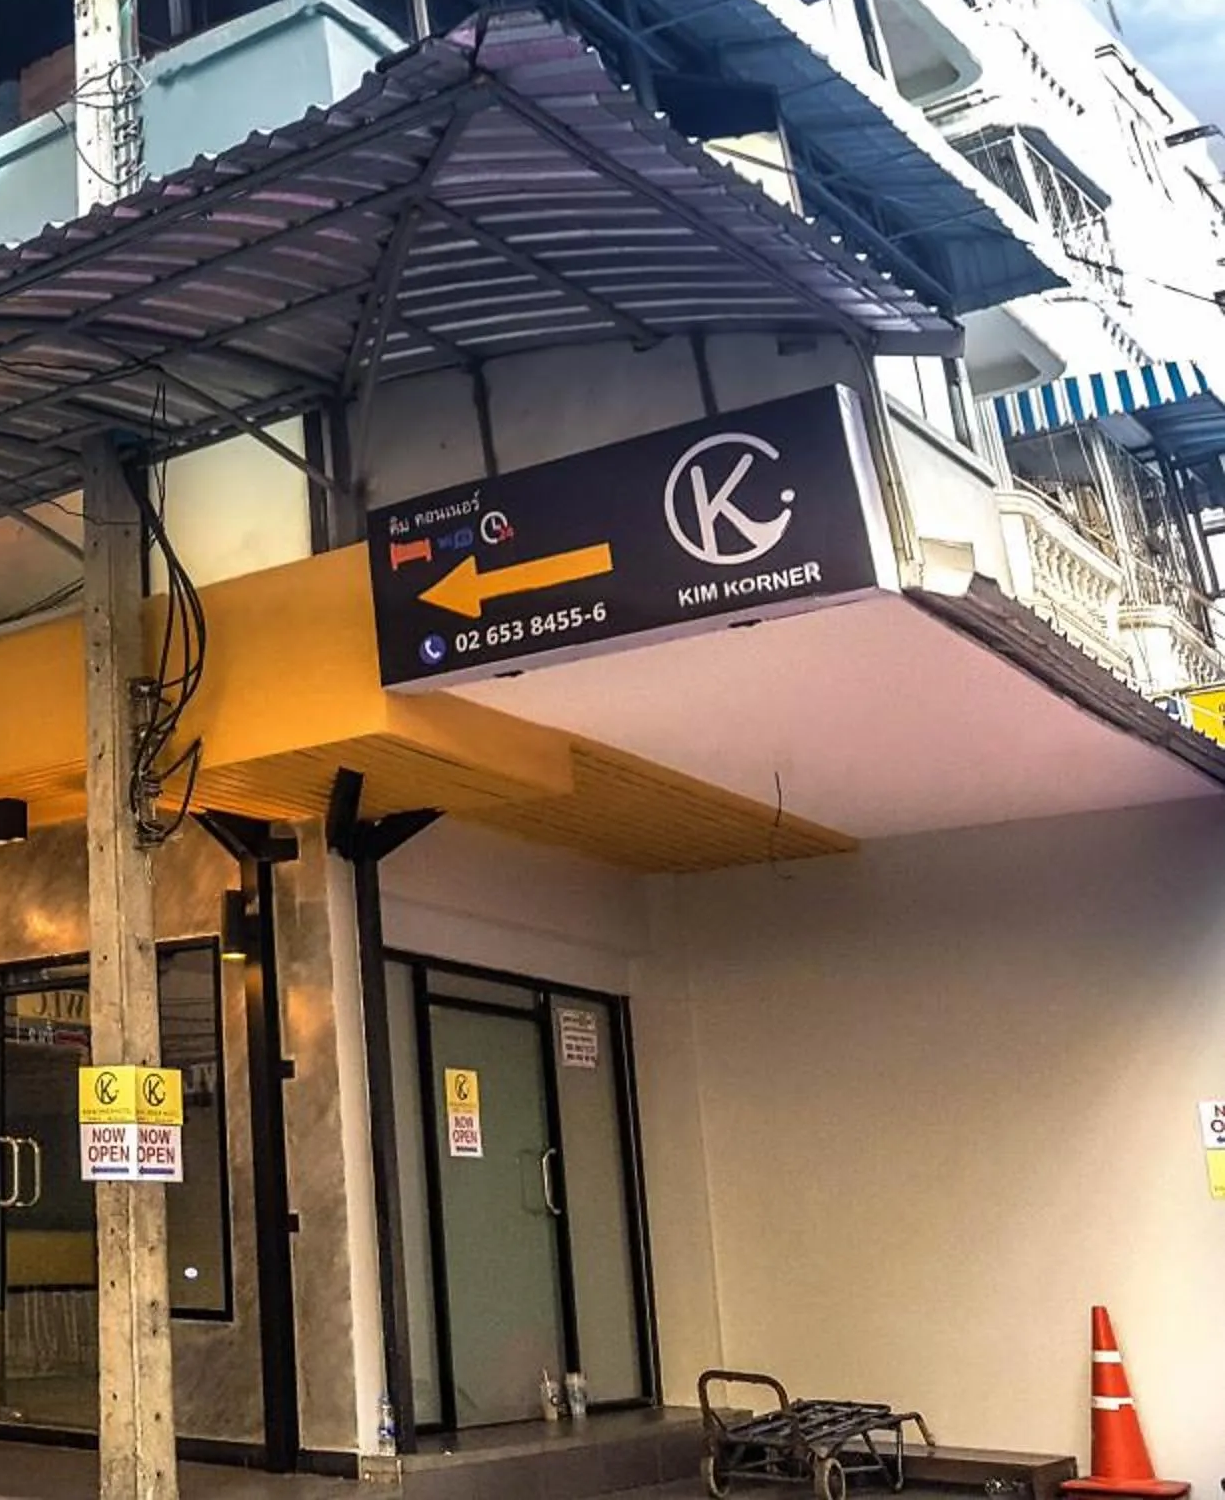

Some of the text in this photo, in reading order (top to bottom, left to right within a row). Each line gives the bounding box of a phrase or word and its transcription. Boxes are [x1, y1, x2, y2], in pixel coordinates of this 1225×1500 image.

[678, 560, 822, 607] KIM KORNER
[455, 601, 607, 653] 02 653 8455-6
[92, 1127, 126, 1143] NOW
[139, 1128, 172, 1145] NOW
[452, 1129, 478, 1144] OPEN
[88, 1145, 130, 1163] OPEN
[137, 1146, 175, 1164] OPEN
